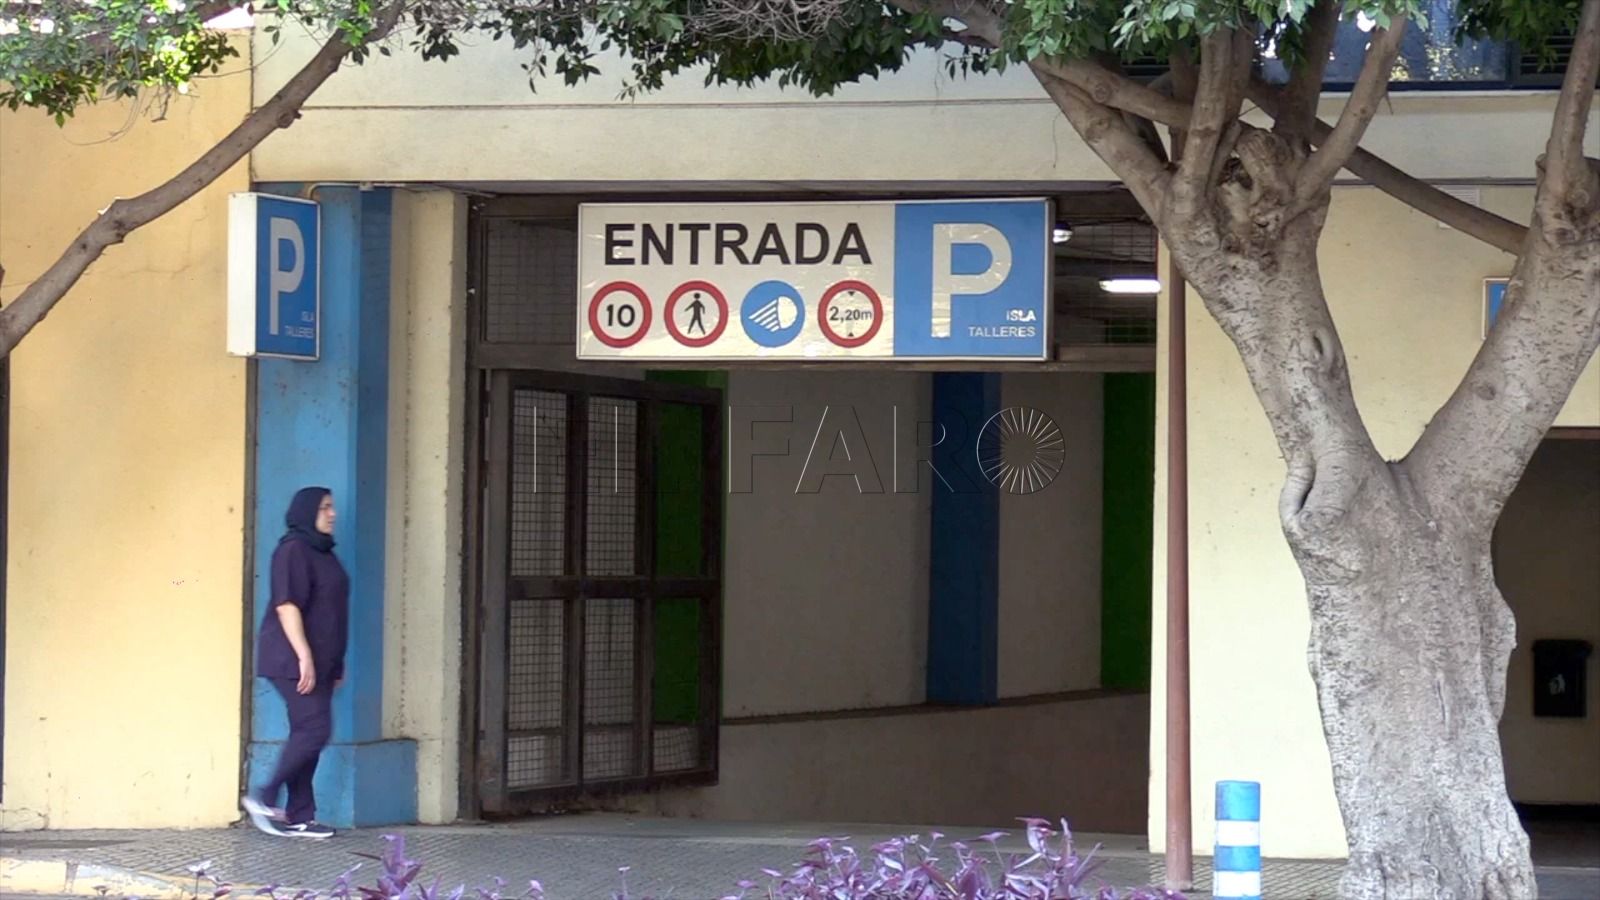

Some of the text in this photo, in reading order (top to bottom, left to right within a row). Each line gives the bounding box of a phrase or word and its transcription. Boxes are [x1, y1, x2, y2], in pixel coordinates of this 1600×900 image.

[604, 222, 872, 265] ENTRADA
[269, 216, 305, 335] P
[931, 222, 1012, 338] P
[606, 304, 635, 327] 10
[829, 306, 872, 323] 2,20m
[1006, 309, 1036, 321] ISLA
[968, 326, 1036, 337] TALLERES
